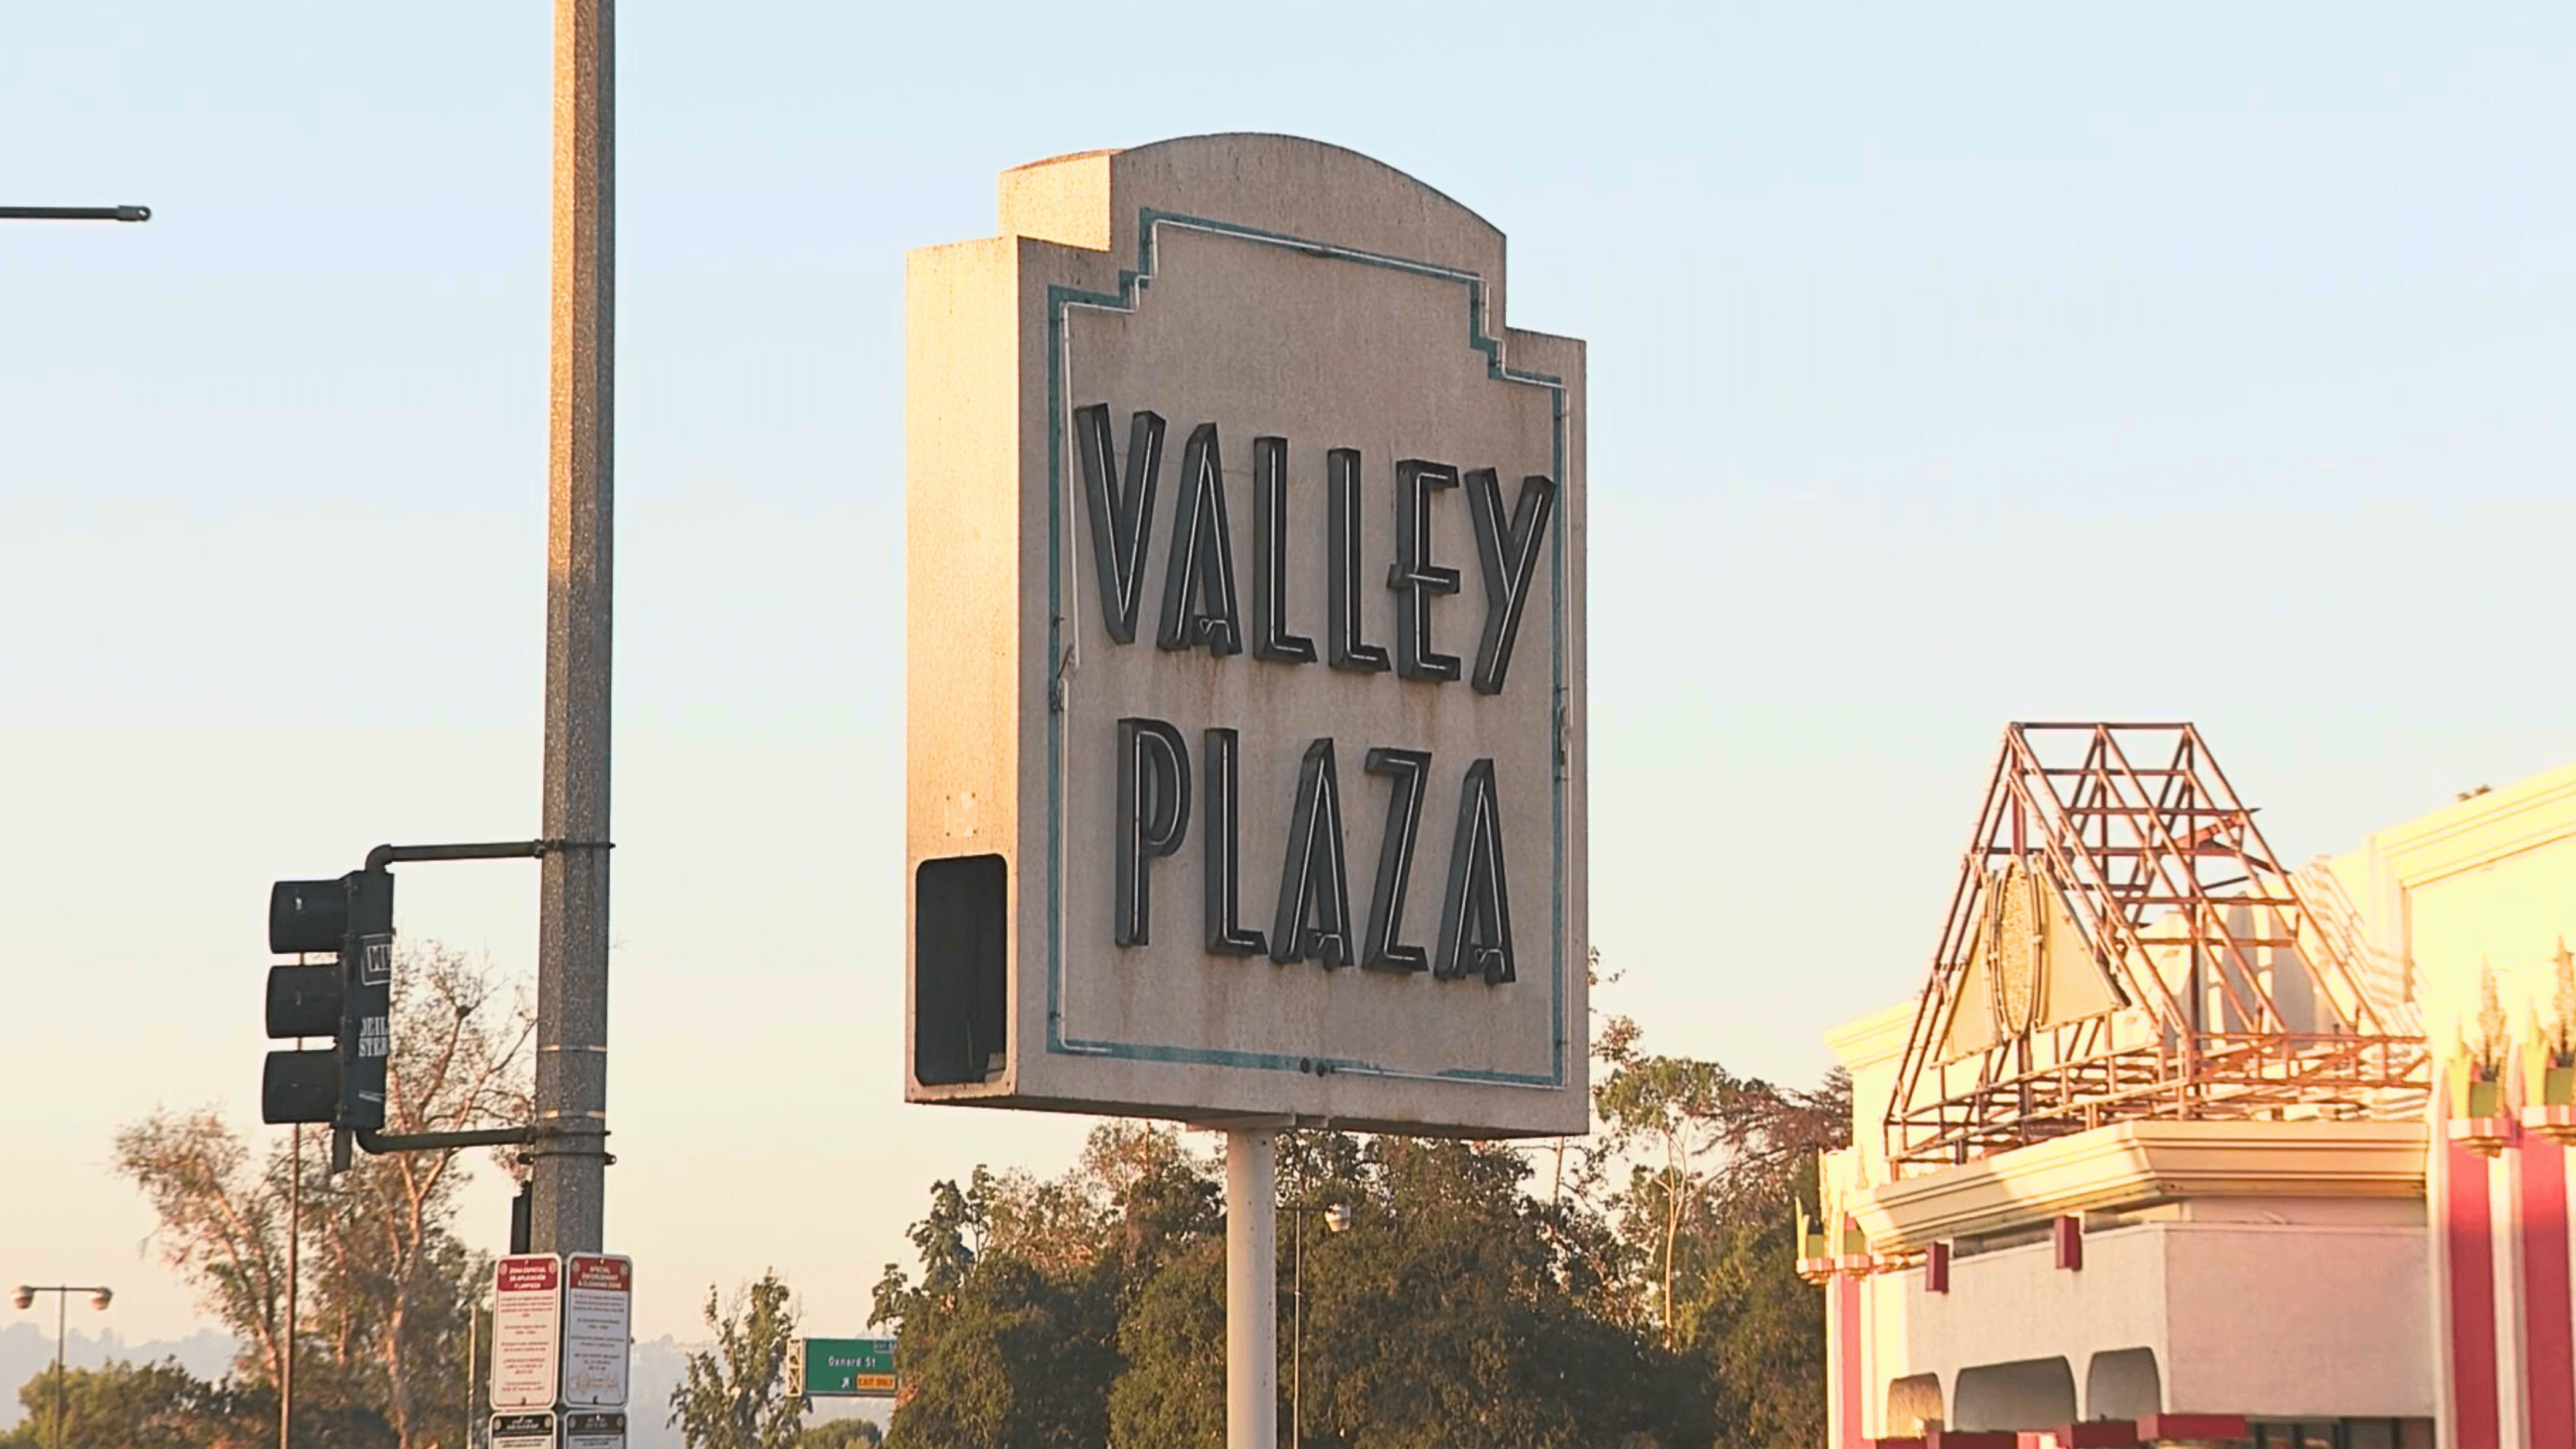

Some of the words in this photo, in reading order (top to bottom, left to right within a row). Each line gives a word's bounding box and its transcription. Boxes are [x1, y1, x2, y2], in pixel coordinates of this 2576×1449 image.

[1075, 402, 1556, 695] VALLEY
[1115, 717, 1516, 983] PLAZA
[865, 1355, 876, 1368] St
